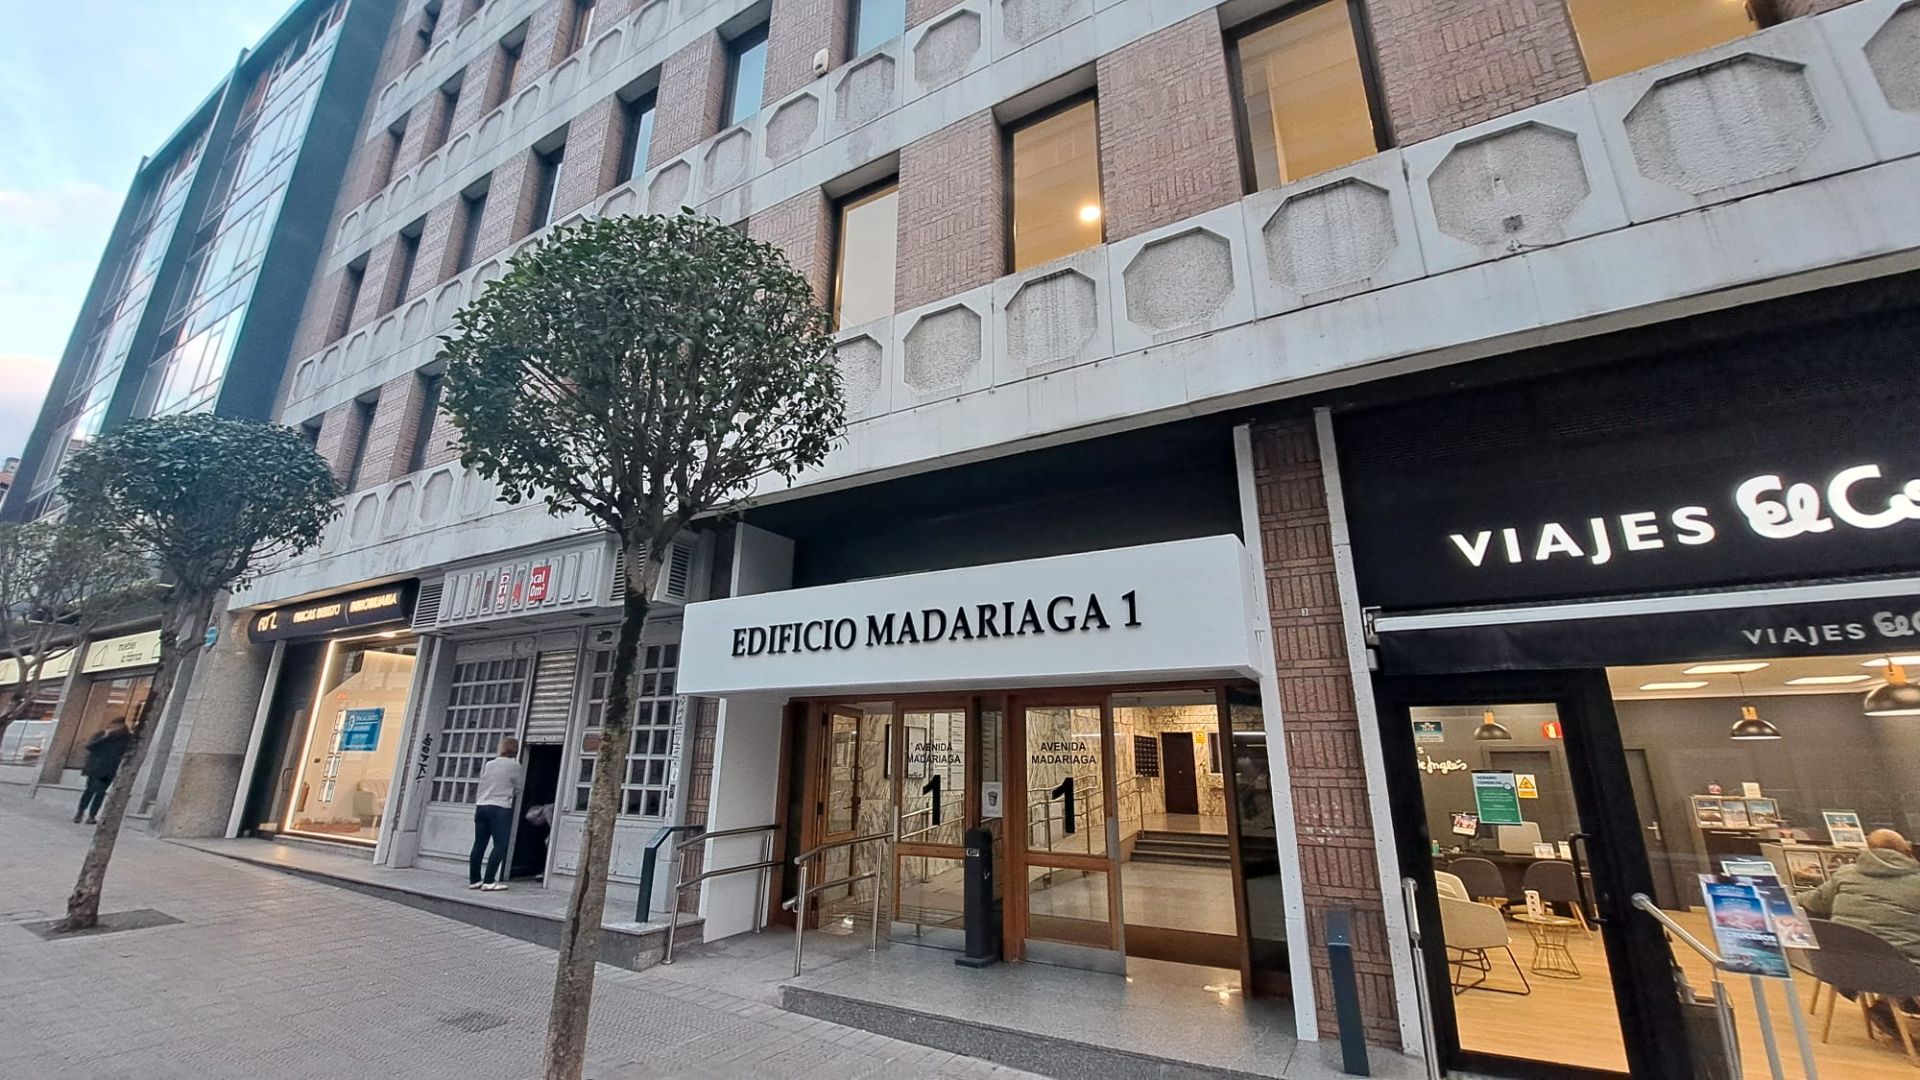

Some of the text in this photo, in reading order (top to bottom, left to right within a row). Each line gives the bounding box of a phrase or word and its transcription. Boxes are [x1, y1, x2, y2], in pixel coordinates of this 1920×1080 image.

[1449, 506, 1716, 567] VIAJES
[1735, 474, 1834, 539] El
[731, 589, 1143, 657] EDIFICIO MADARIAGA 1
[1743, 622, 1866, 646] VIAJES
[914, 742, 953, 752] AVENIDA
[1040, 741, 1087, 752] AVENIDA
[907, 754, 961, 764] MADARIAGA
[1031, 754, 1097, 765] MADARIAGA
[922, 774, 941, 826] 1
[1051, 777, 1075, 833] 1
